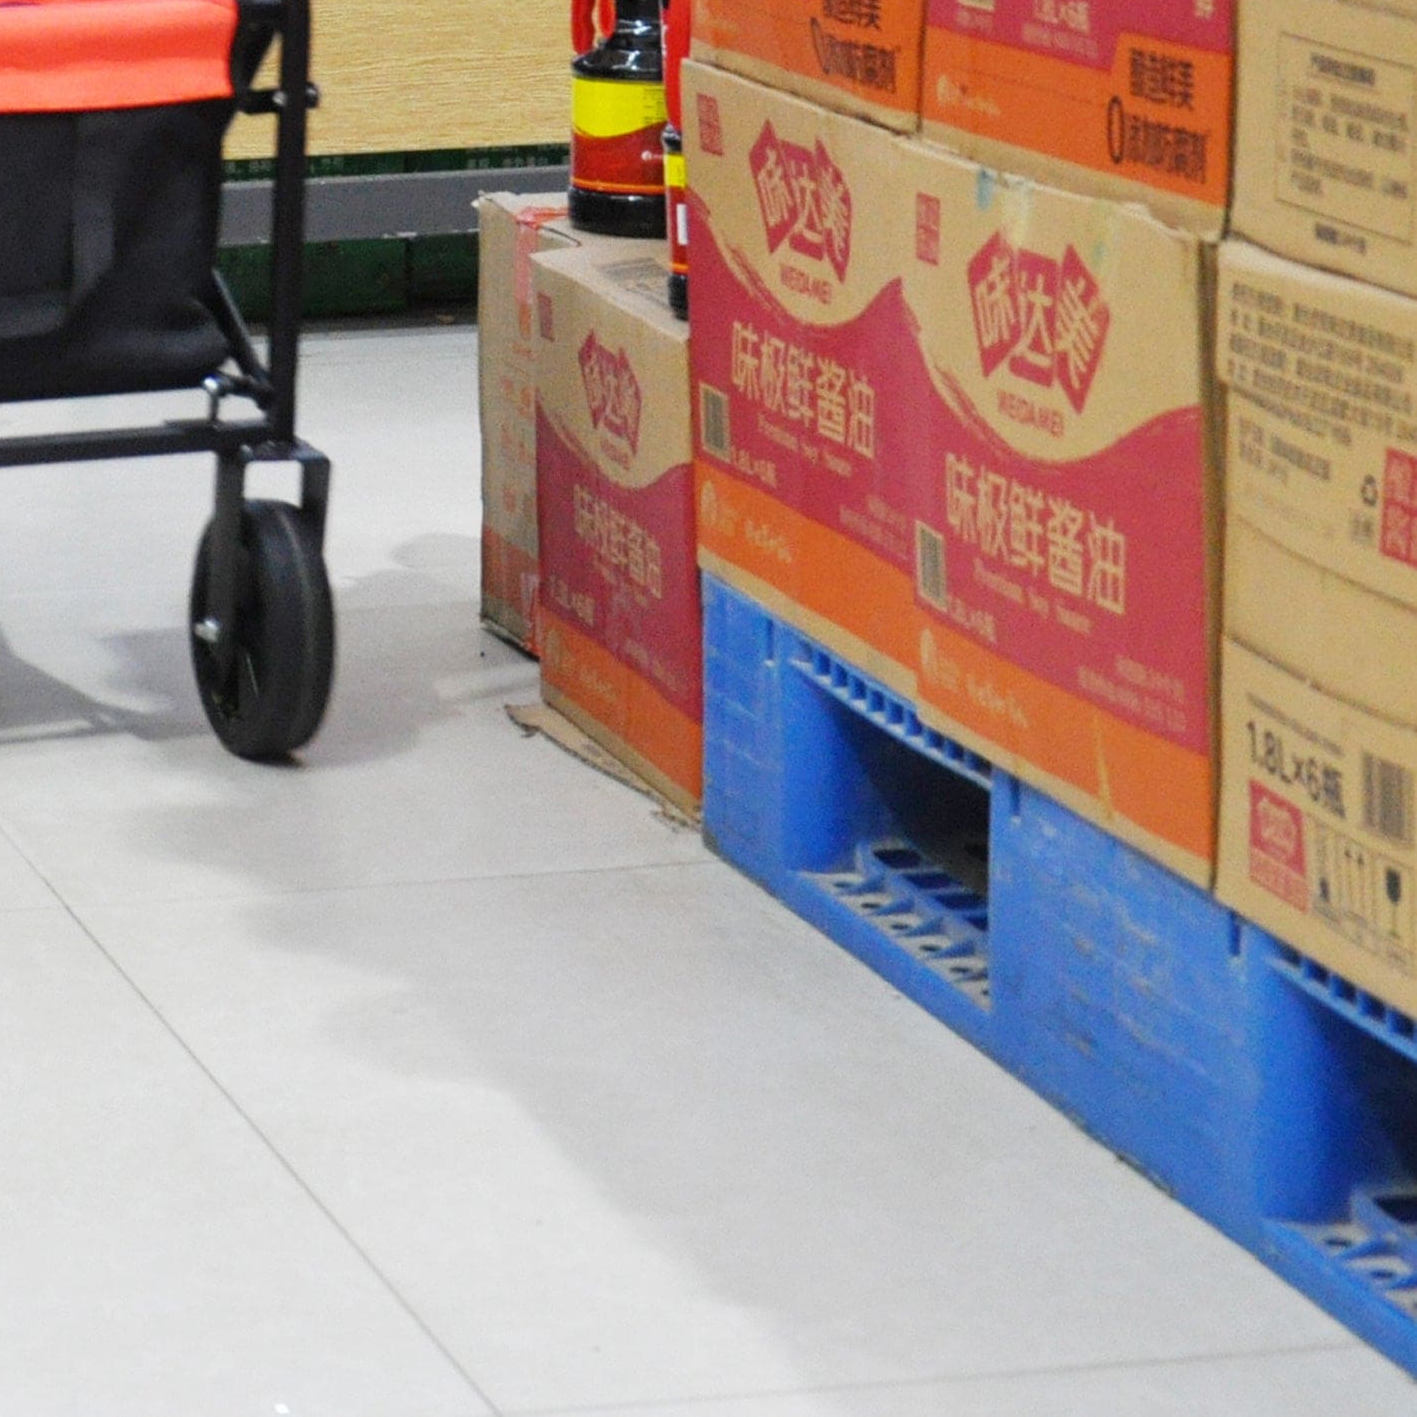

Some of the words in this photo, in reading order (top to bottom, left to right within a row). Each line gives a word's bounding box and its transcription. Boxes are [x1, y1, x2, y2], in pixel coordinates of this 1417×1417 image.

[754, 142, 849, 268] 味达美
[733, 320, 877, 461] 味极鲜酱油
[970, 248, 1105, 396] 味达美
[945, 451, 1126, 615] 味极鲜酱油
